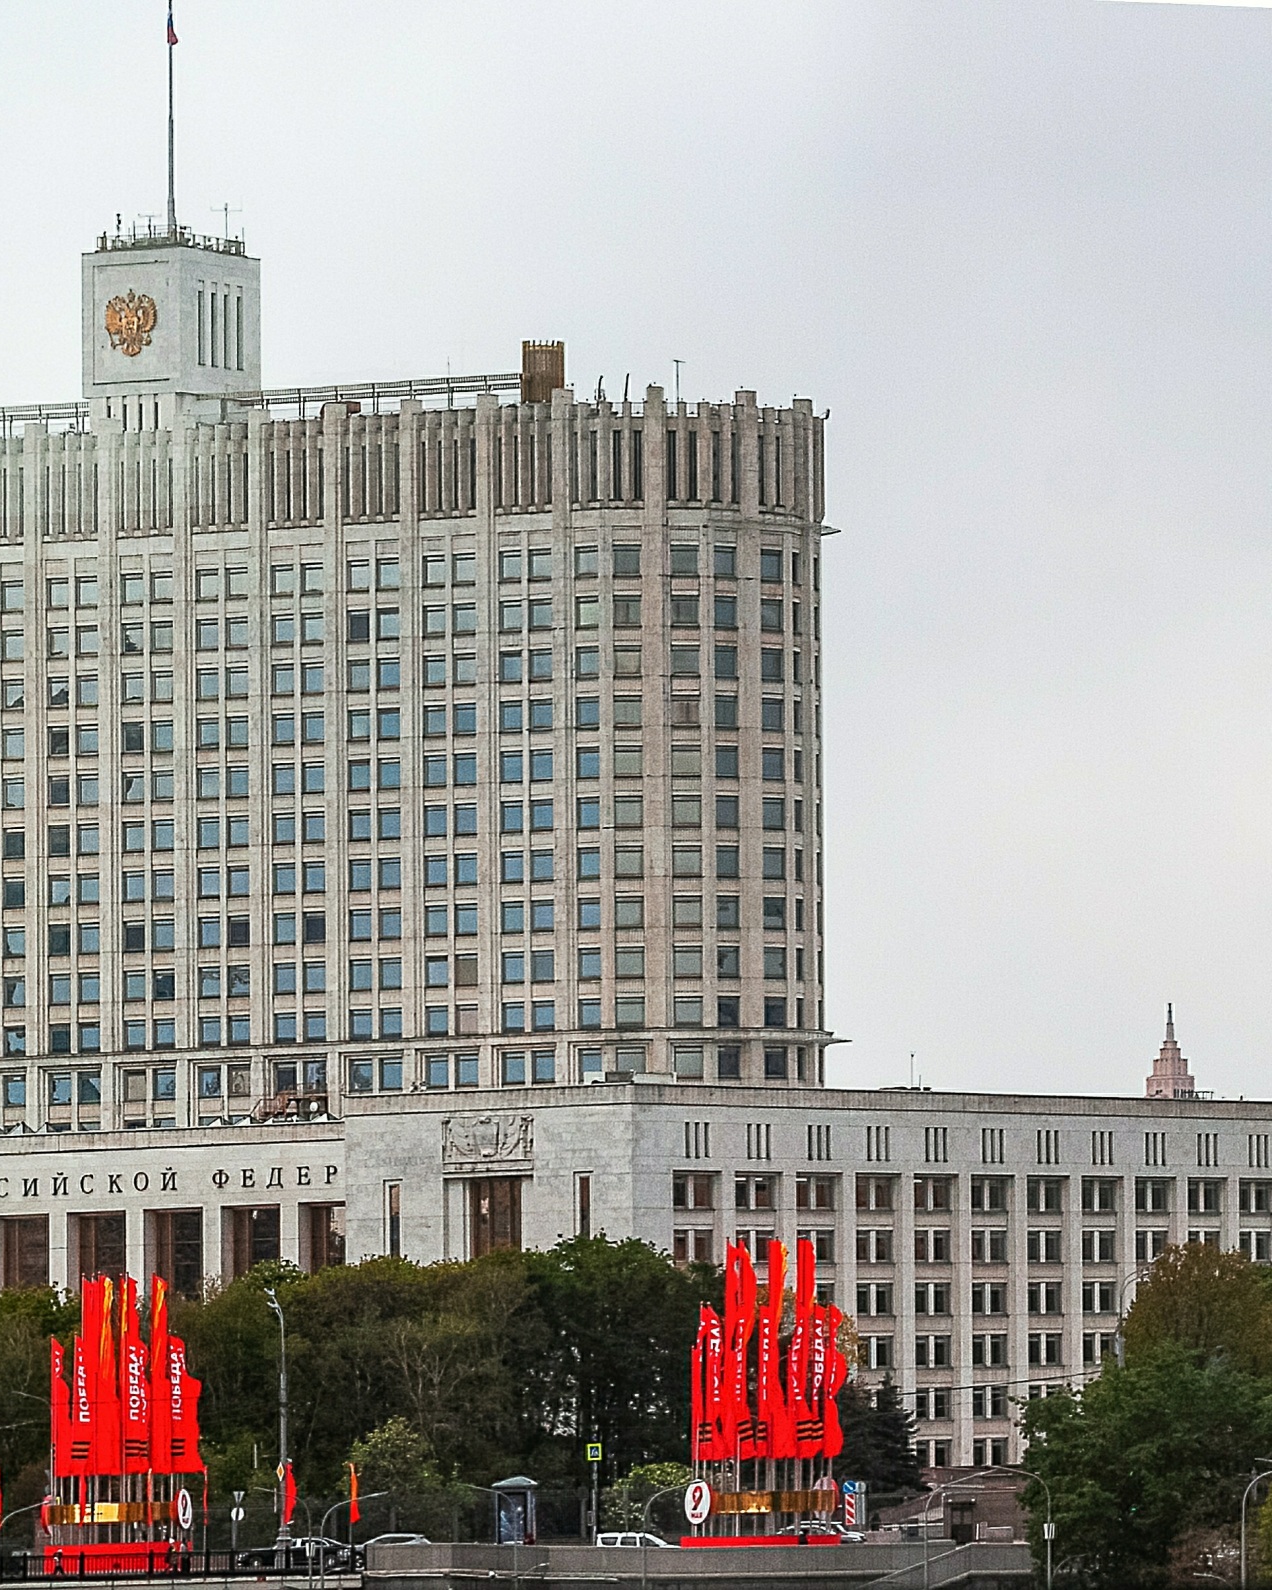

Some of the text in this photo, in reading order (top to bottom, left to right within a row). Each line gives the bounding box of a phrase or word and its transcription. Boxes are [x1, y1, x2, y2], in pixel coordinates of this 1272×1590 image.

[77, 1347, 91, 1423] ПОБЕД
[128, 1345, 141, 1421] ПОБЕДА!
[692, 1485, 703, 1511] 9
